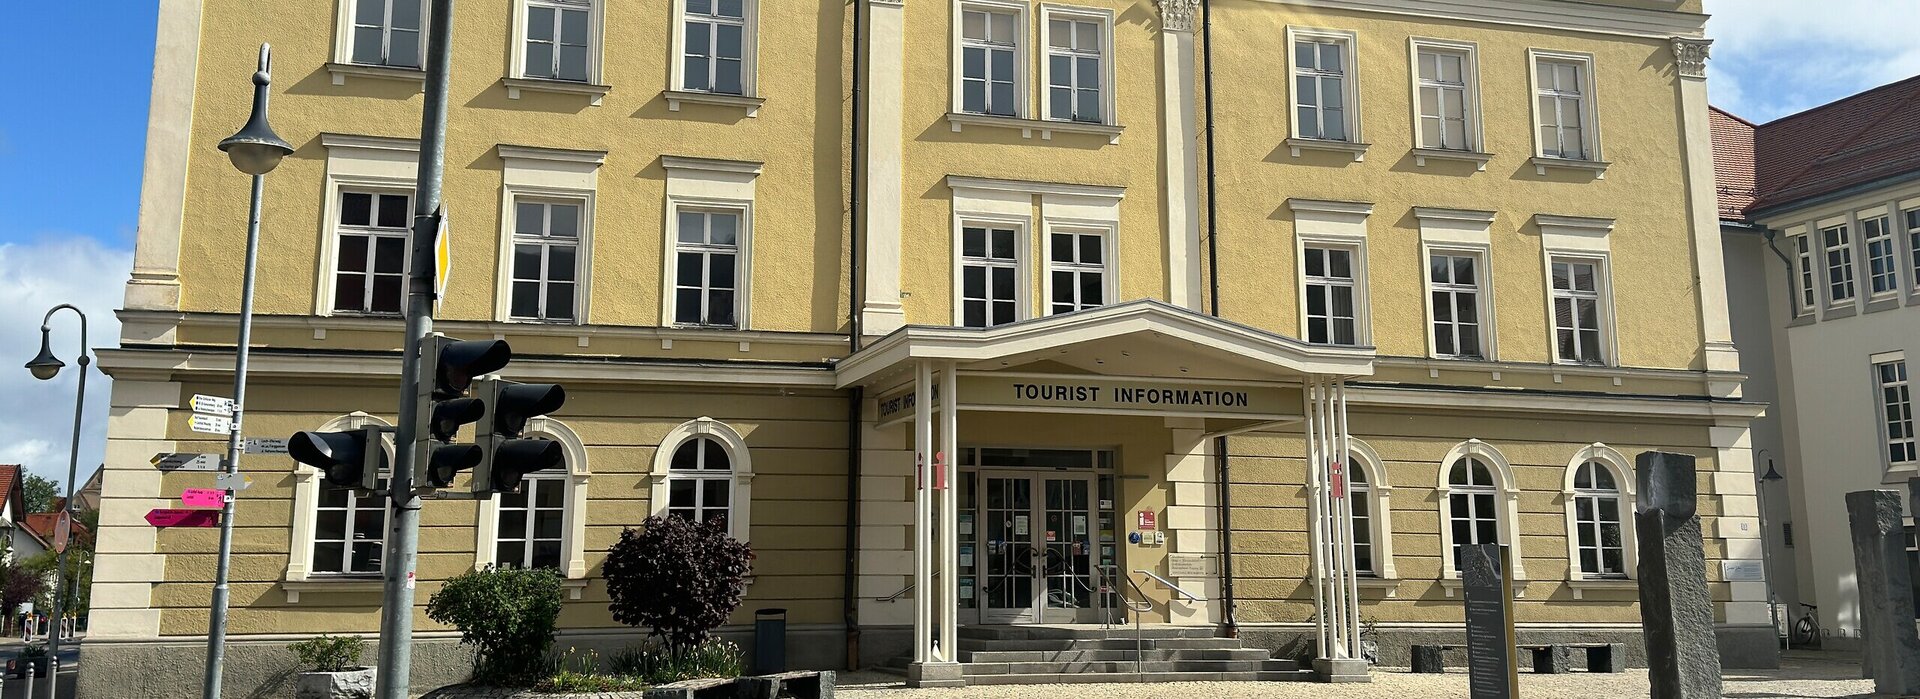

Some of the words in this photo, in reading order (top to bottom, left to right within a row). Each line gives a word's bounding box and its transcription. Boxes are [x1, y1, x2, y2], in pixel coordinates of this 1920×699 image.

[881, 397, 900, 418] TOURIST
[903, 384, 939, 409] INFOON
[1013, 384, 1100, 402] TOURIST
[1114, 387, 1248, 407] INFORMATION
